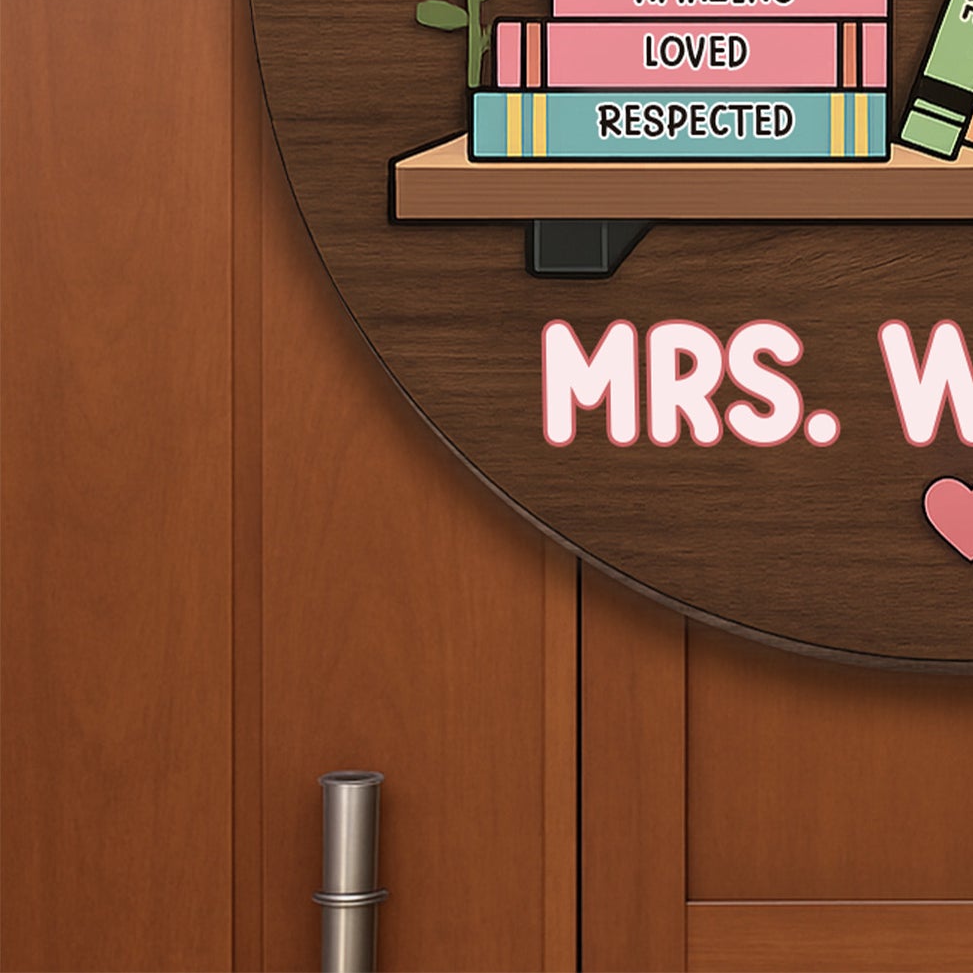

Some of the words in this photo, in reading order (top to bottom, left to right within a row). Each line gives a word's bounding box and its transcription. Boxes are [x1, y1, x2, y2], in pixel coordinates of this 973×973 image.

[644, 35, 748, 68] LOVED
[597, 103, 794, 137] RESPECTED
[541, 319, 840, 447] MRS.
